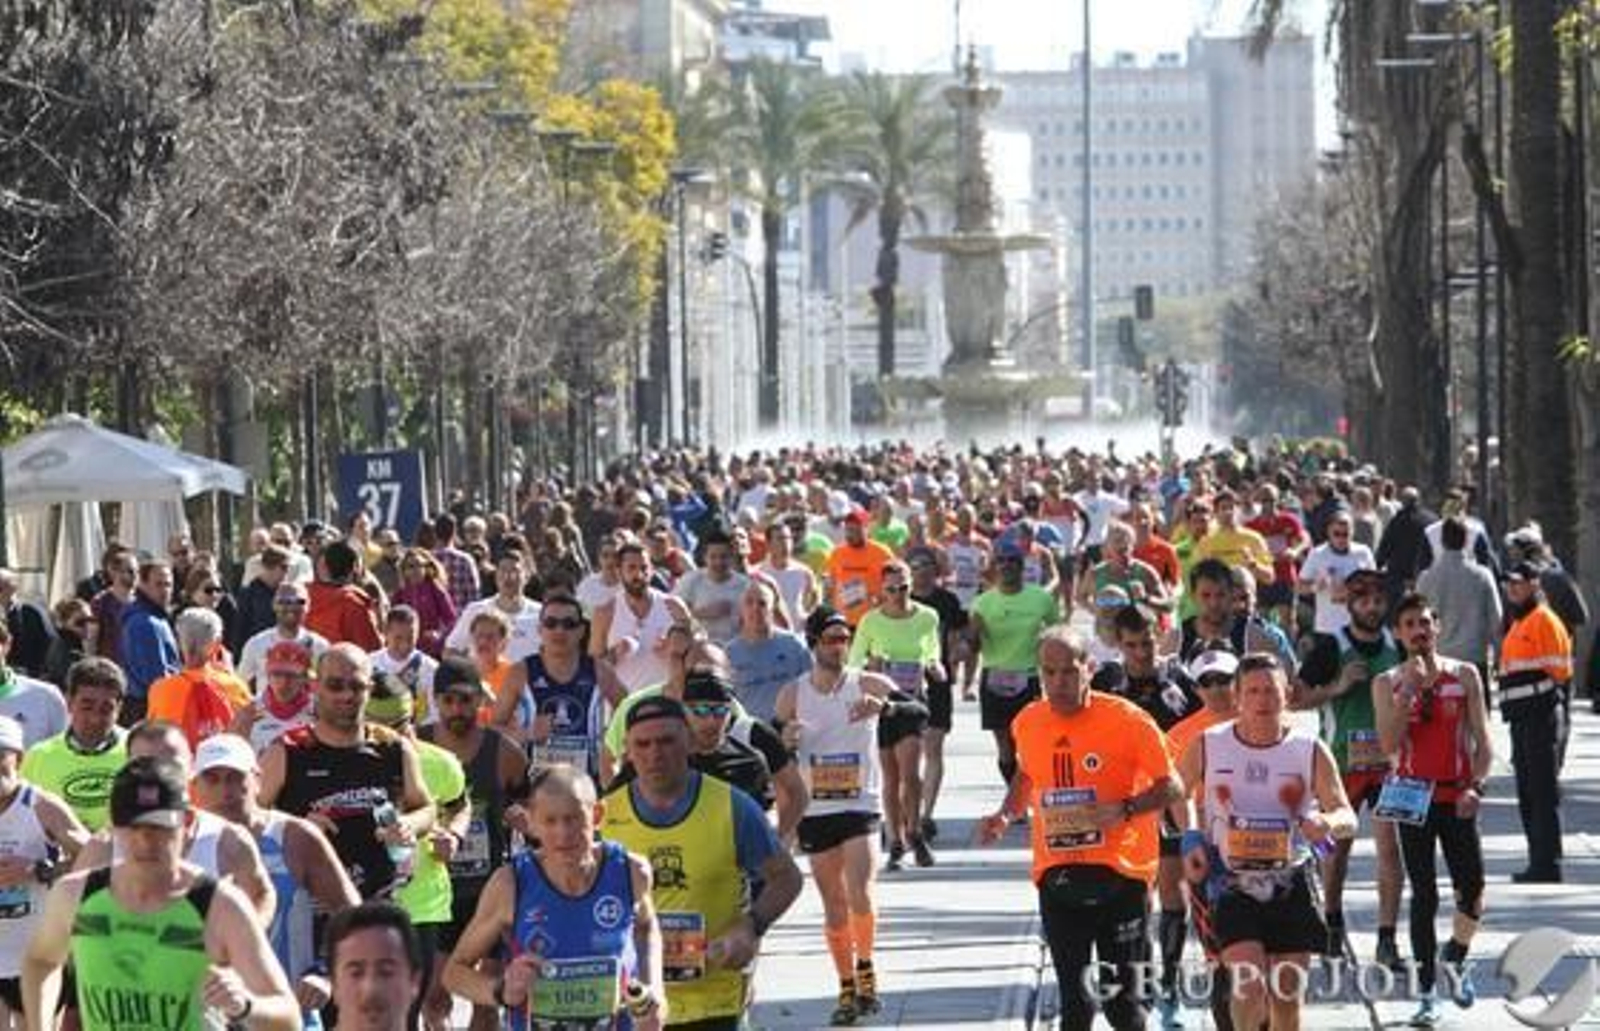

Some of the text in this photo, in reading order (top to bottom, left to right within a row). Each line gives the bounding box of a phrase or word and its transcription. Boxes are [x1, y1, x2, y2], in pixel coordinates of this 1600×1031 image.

[367, 458, 391, 480] KM
[358, 482, 402, 528] 37
[555, 987, 598, 1005] 1045
